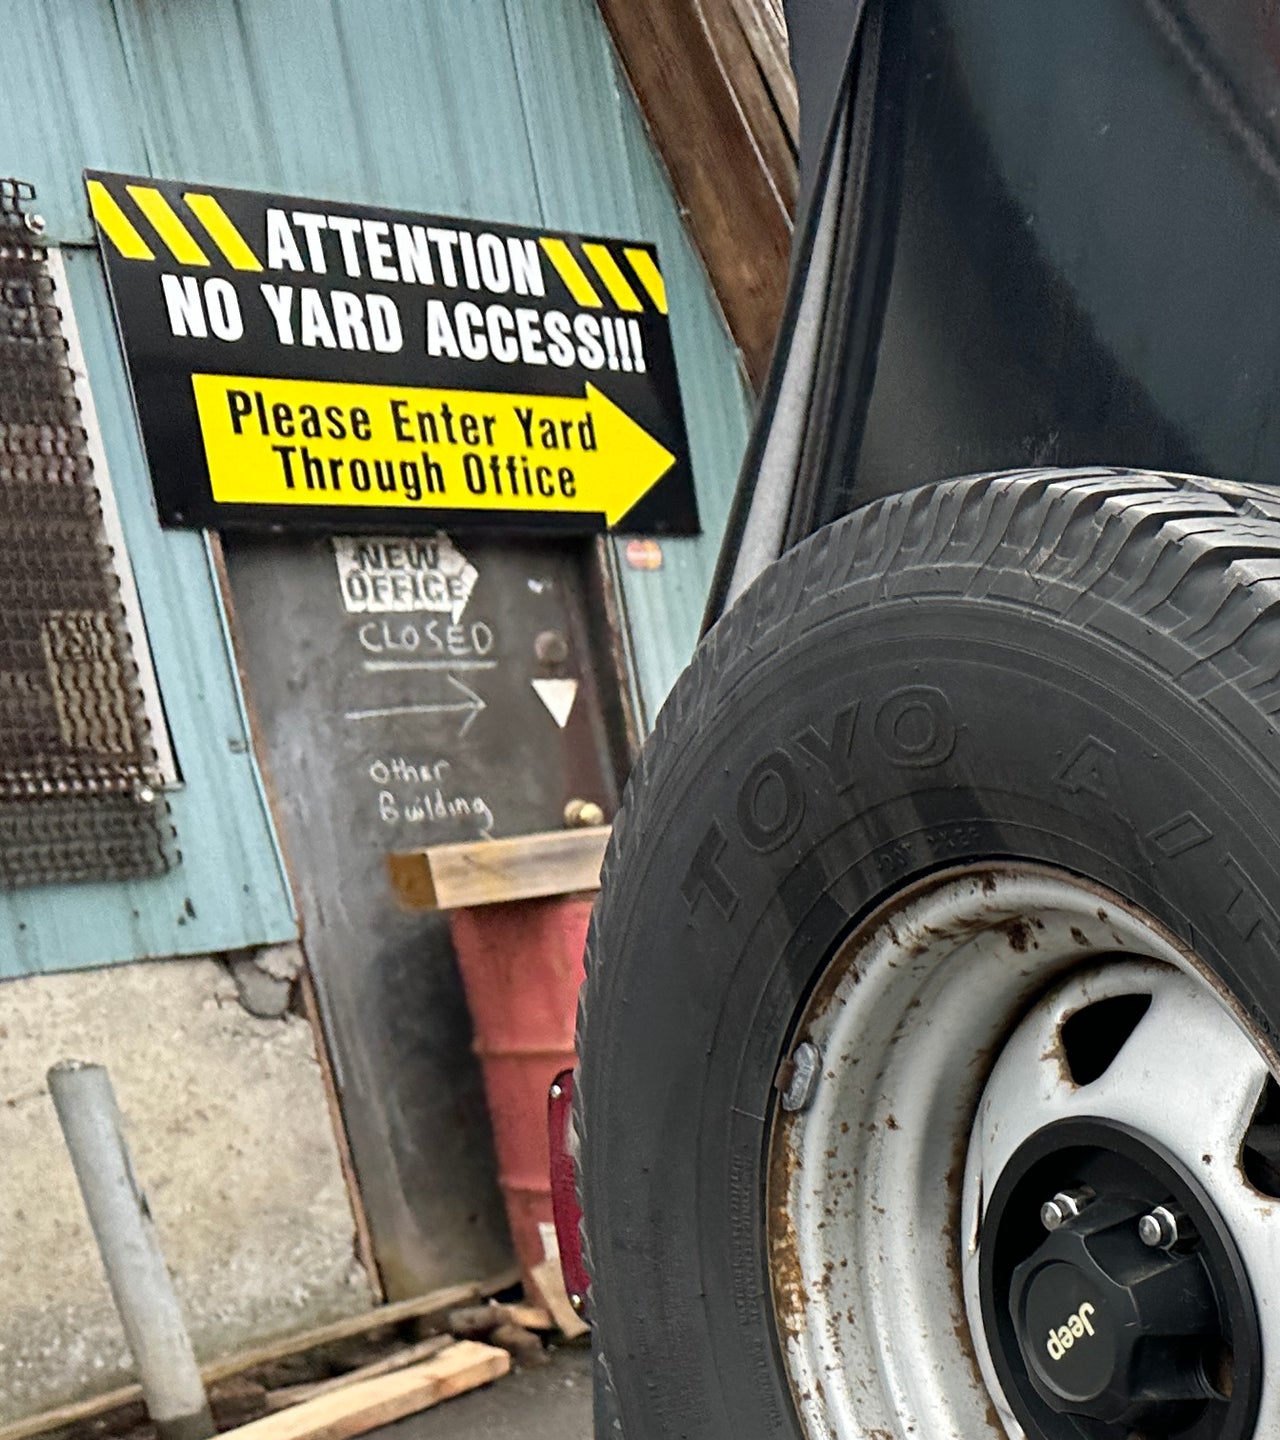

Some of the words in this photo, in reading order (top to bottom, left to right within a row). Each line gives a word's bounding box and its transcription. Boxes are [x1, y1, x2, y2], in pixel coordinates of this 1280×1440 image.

[266, 208, 546, 297] ATTENTION
[161, 273, 244, 342] NO
[260, 283, 403, 354] YARD
[426, 299, 647, 374] ACCESS!!!
[226, 389, 372, 441] Please
[390, 399, 496, 447] Enter
[513, 406, 597, 451] Yard
[271, 444, 446, 501] Through
[462, 451, 577, 499] Office
[346, 567, 466, 602] OFFICE
[353, 542, 441, 570] NEW
[358, 619, 495, 656] CLOSED
[680, 684, 962, 922] TOYO
[1046, 1302, 1095, 1361] Jeep
